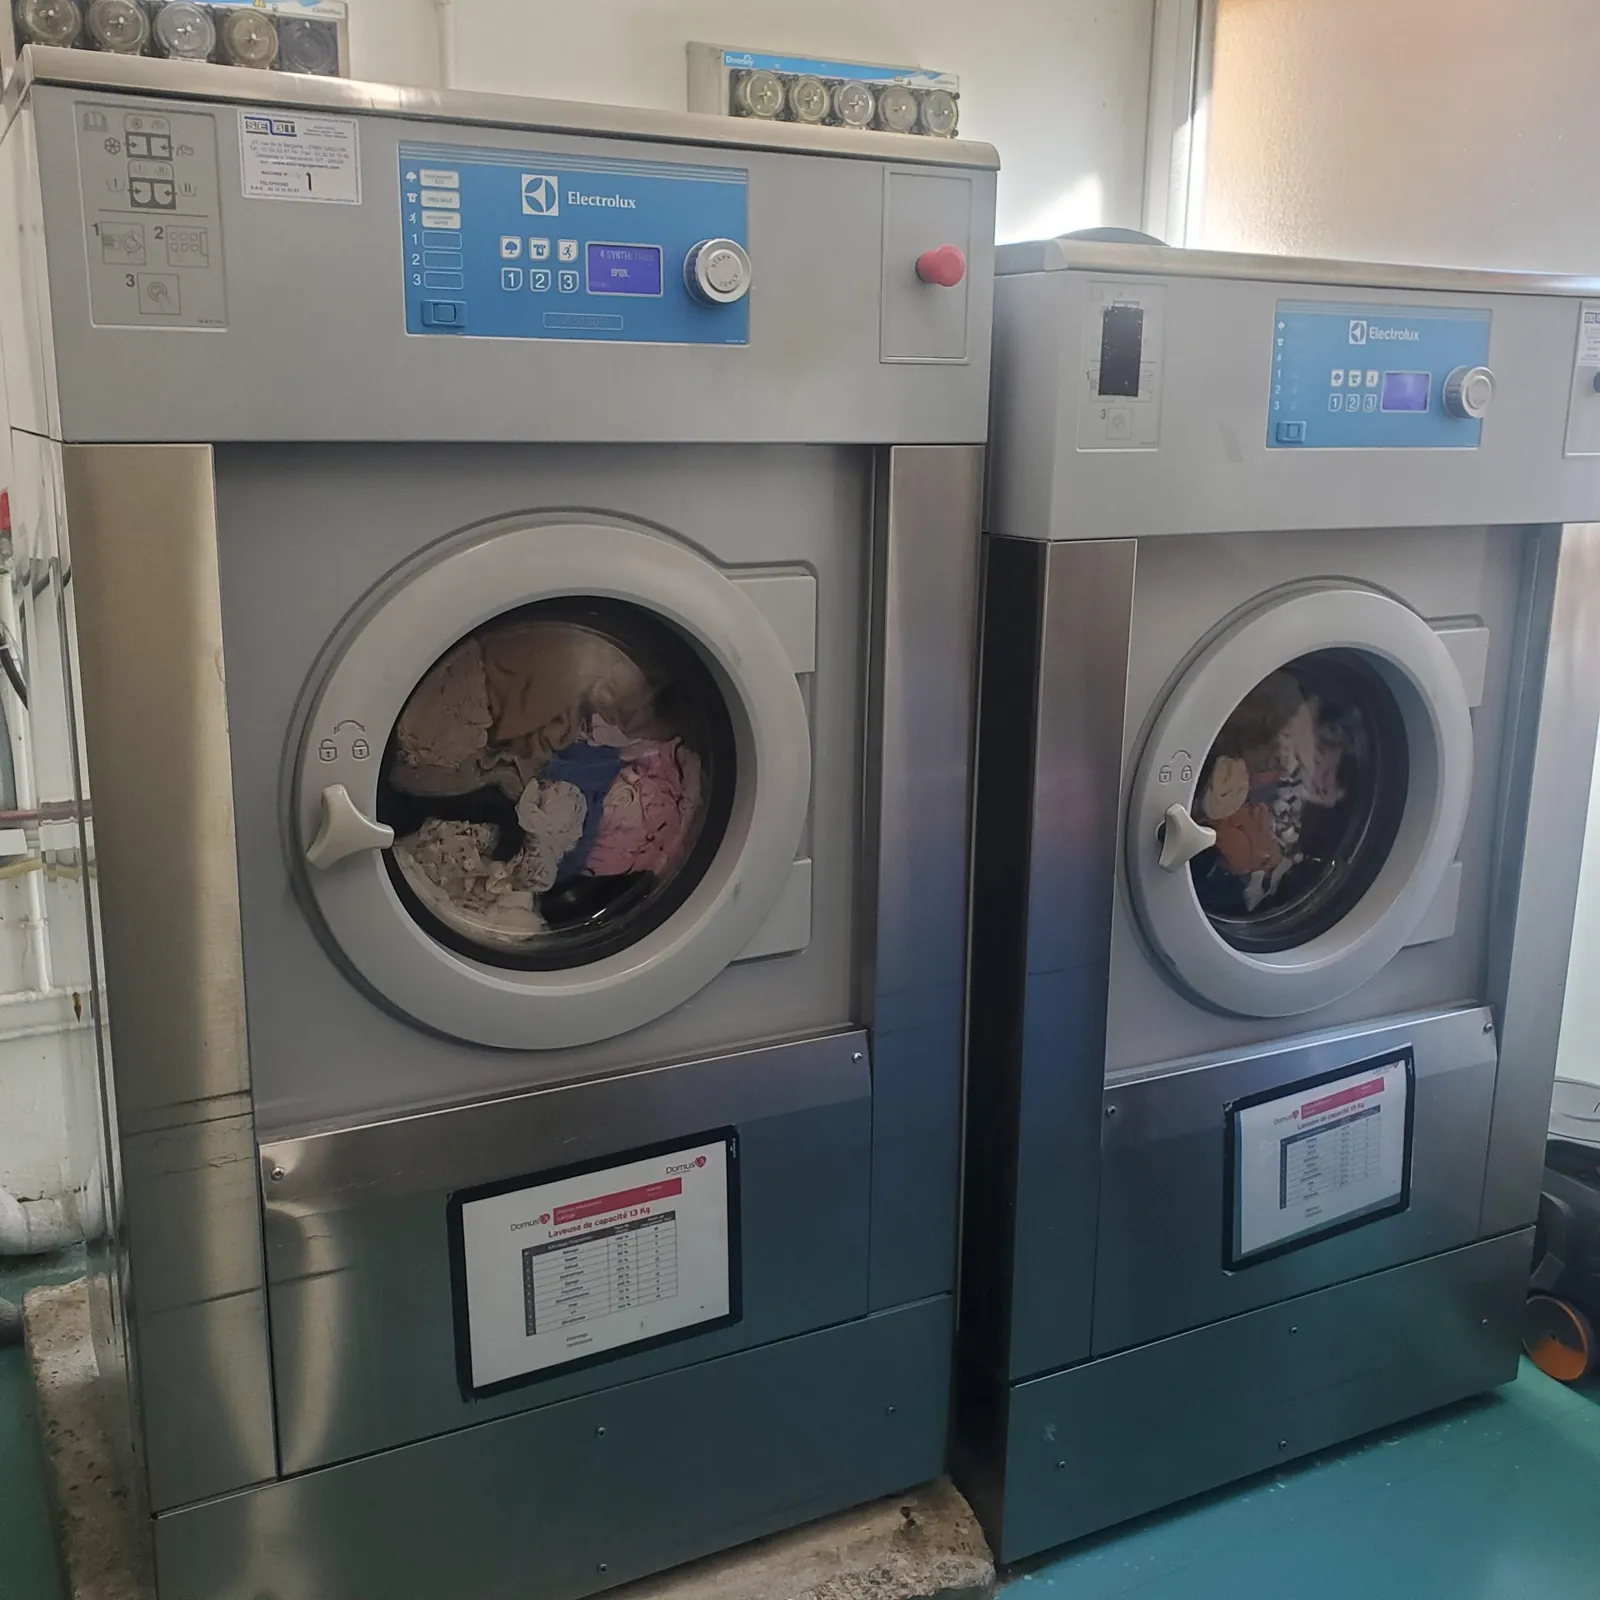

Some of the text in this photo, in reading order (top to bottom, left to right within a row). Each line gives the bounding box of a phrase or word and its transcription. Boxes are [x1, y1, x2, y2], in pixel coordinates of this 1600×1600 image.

[305, 171, 312, 191] 1
[567, 190, 637, 209] Electrolux
[92, 222, 100, 236] 1
[154, 226, 164, 239] 2
[412, 233, 418, 245] 1
[412, 254, 420, 265] 2
[125, 274, 135, 287] 3
[413, 274, 421, 286] 3
[508, 273, 514, 287] 1
[535, 274, 545, 288] 2
[563, 275, 573, 289] 3
[1369, 326, 1420, 341] Electrolux
[1273, 401, 1280, 410] 3
[1332, 398, 1338, 409] 1
[1348, 398, 1356, 410] 2
[1366, 398, 1373, 410] 3
[1100, 408, 1106, 420] 3
[666, 1161, 696, 1175] Domus
[510, 1218, 540, 1232] Domus
[548, 1225, 582, 1238] Laveuse
[583, 1221, 592, 1229] de
[594, 1211, 628, 1228] capacité
[629, 1208, 639, 1218] 13
[640, 1206, 651, 1216] Kg
